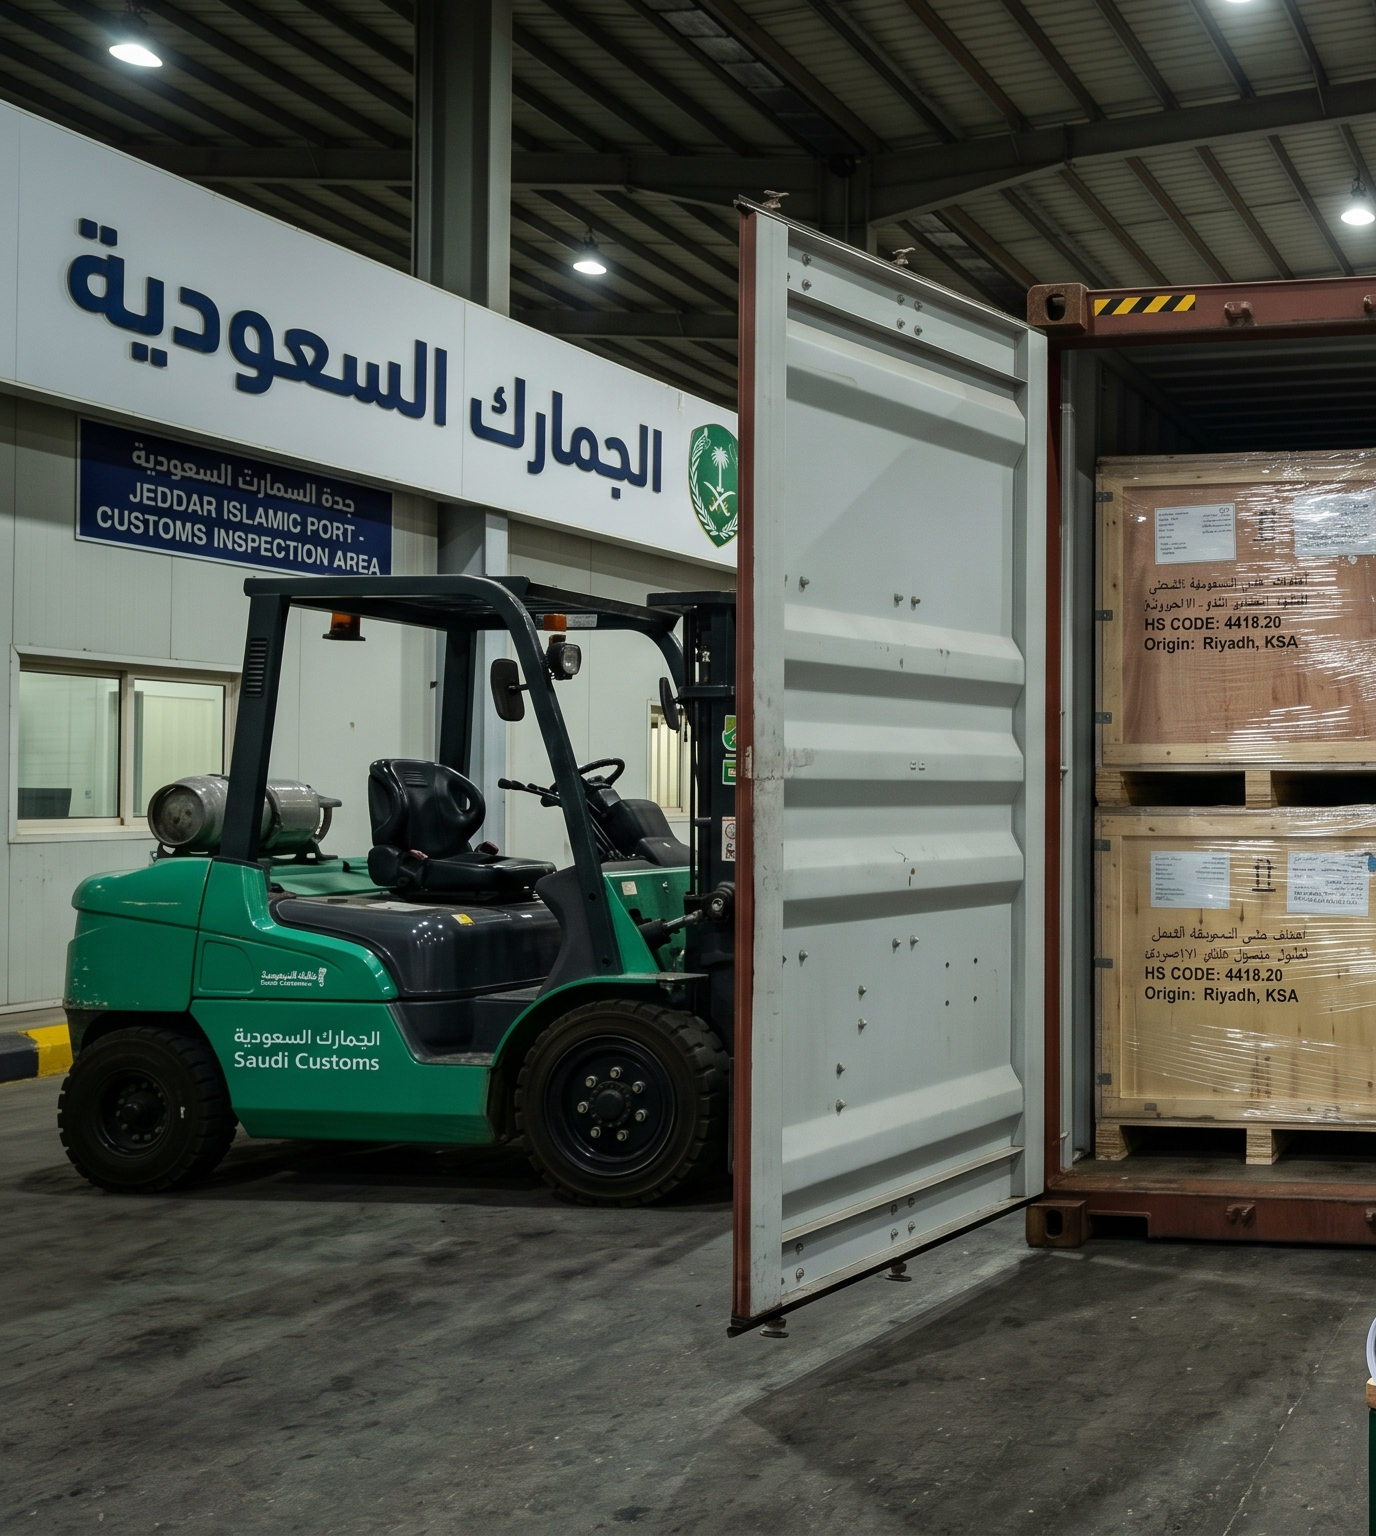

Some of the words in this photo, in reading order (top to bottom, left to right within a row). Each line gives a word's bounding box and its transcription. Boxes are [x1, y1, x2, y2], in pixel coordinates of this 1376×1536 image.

[66, 218, 448, 427] السعودية
[470, 377, 663, 500] الجمارك
[132, 442, 232, 486] السعودية
[129, 482, 217, 518] JEDDAR
[223, 499, 302, 534] ISLAMIC
[306, 516, 356, 544] PORT
[321, 487, 356, 518] جدة
[96, 505, 207, 546] CUSTOMS
[213, 526, 329, 567] INSPECTION
[332, 550, 381, 575] AREA
[1144, 618, 1166, 631] HS
[1170, 617, 1220, 631] CODE:
[1224, 615, 1282, 630] 4418.20
[1144, 637, 1195, 654] Origin:
[1203, 636, 1260, 653] Riyadh,
[1265, 635, 1299, 649] KSA
[1144, 966, 1166, 981] HS
[1170, 967, 1221, 982] CODE:
[1225, 967, 1283, 982] 4418.20
[1144, 986, 1196, 1004] Origin:
[1204, 987, 1261, 1005] Riyadh,
[1265, 988, 1299, 1003] KSA
[234, 1027, 312, 1048] السعودية
[316, 1029, 381, 1050] الجمارك
[234, 1051, 289, 1069] Saudi
[295, 1052, 380, 1071] Customs
